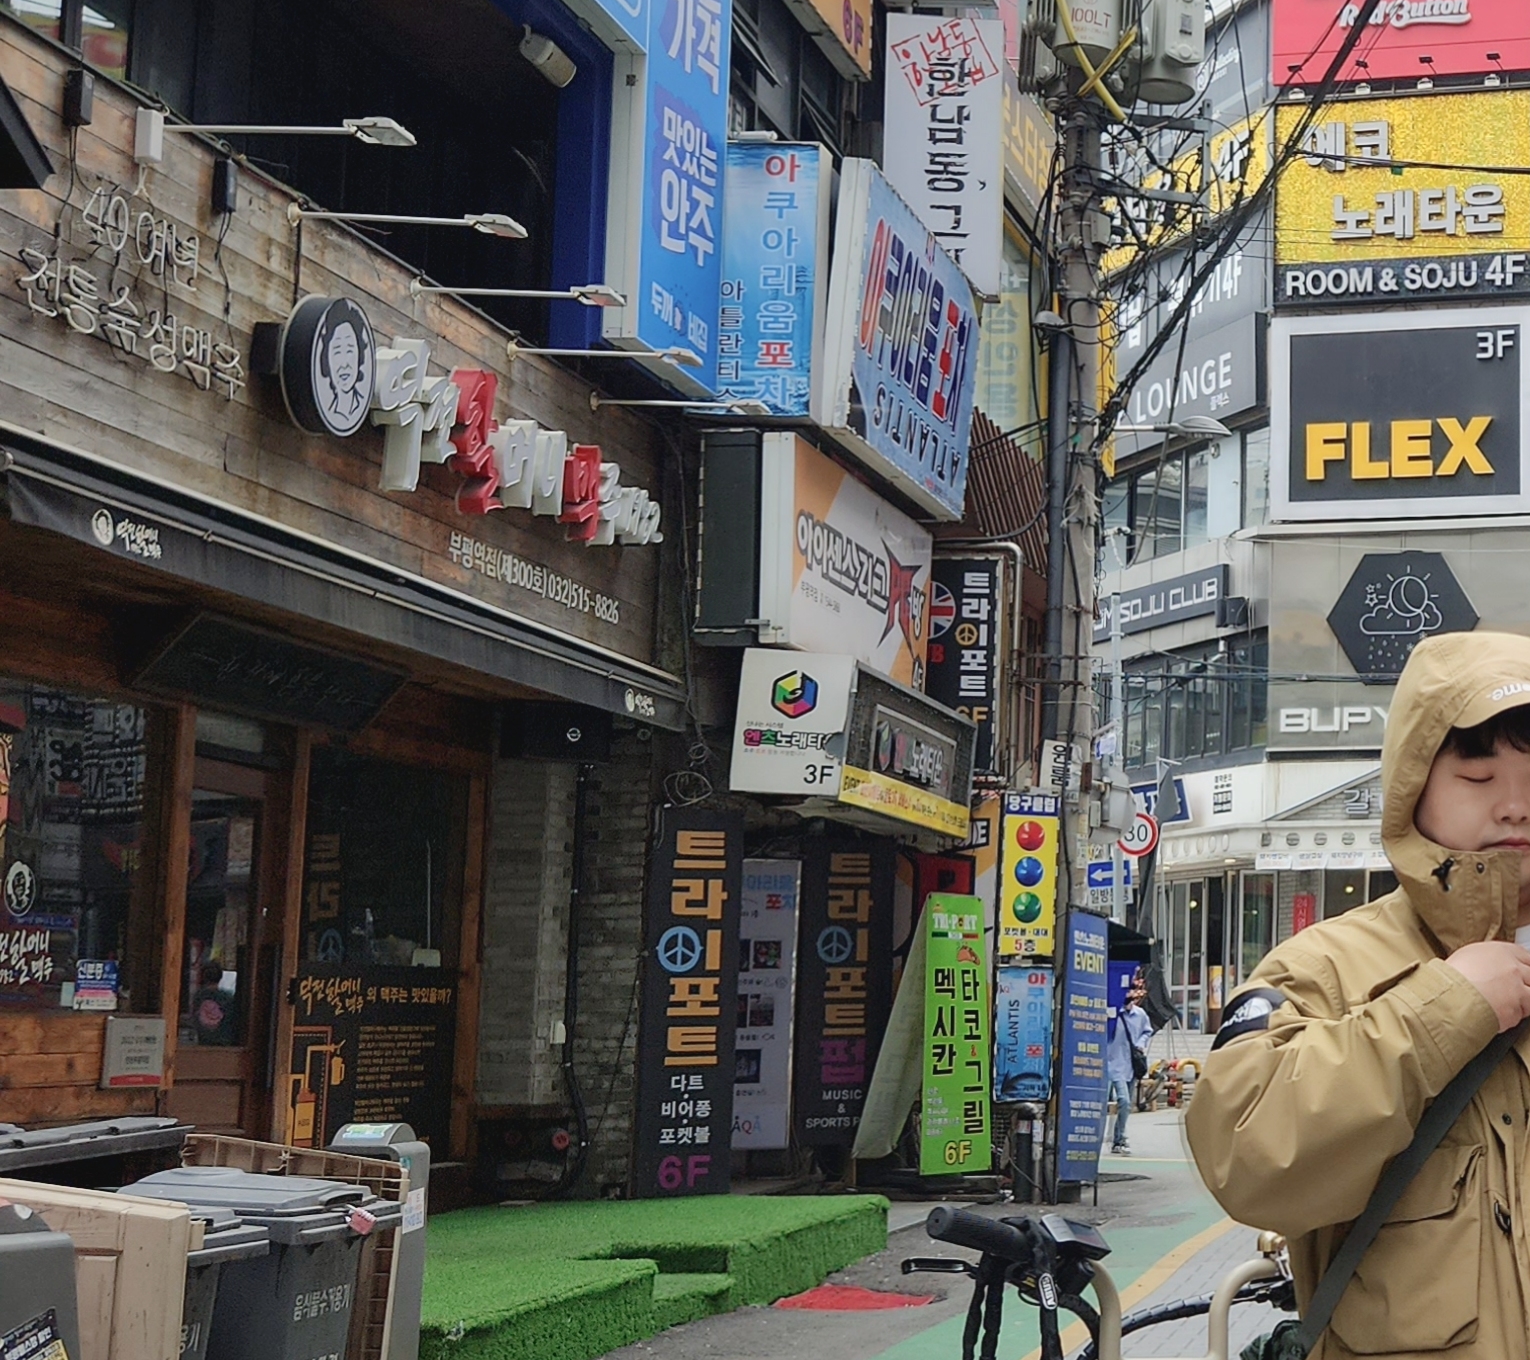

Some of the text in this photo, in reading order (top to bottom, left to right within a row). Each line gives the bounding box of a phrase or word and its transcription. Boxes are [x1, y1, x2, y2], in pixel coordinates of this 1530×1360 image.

[1339, 0, 1386, 29] Rd
[662, 103, 719, 193] 맛있는
[1304, 120, 1393, 172] 에코
[659, 172, 716, 268] 안주
[1331, 183, 1507, 242] 노래타운
[1285, 253, 1527, 296] ROOM & SOJU 4F
[1475, 329, 1516, 360] 3F
[1135, 351, 1233, 424] LOUNGE
[872, 385, 962, 488] ATLANTIS
[1304, 415, 1496, 481] FLEX
[1119, 577, 1218, 623] SOJU CLUB
[802, 763, 834, 786] 3F
[1123, 824, 1147, 843] 30
[1013, 938, 1037, 953] 5층
[1073, 950, 1105, 974] EVENT
[931, 967, 958, 1077] 멕시칸
[1006, 998, 1021, 1064] ATLANTIS
[959, 968, 985, 1136] 타코 그릴
[670, 1074, 705, 1093] 다트
[821, 1088, 863, 1100] MUSIC
[660, 1100, 713, 1119] 비어퐁
[804, 1116, 852, 1130] SPORTS
[836, 1102, 847, 1114] &
[658, 1125, 711, 1145] 포켓볼
[943, 1138, 974, 1166] 6F
[657, 1155, 712, 1189] 6F
